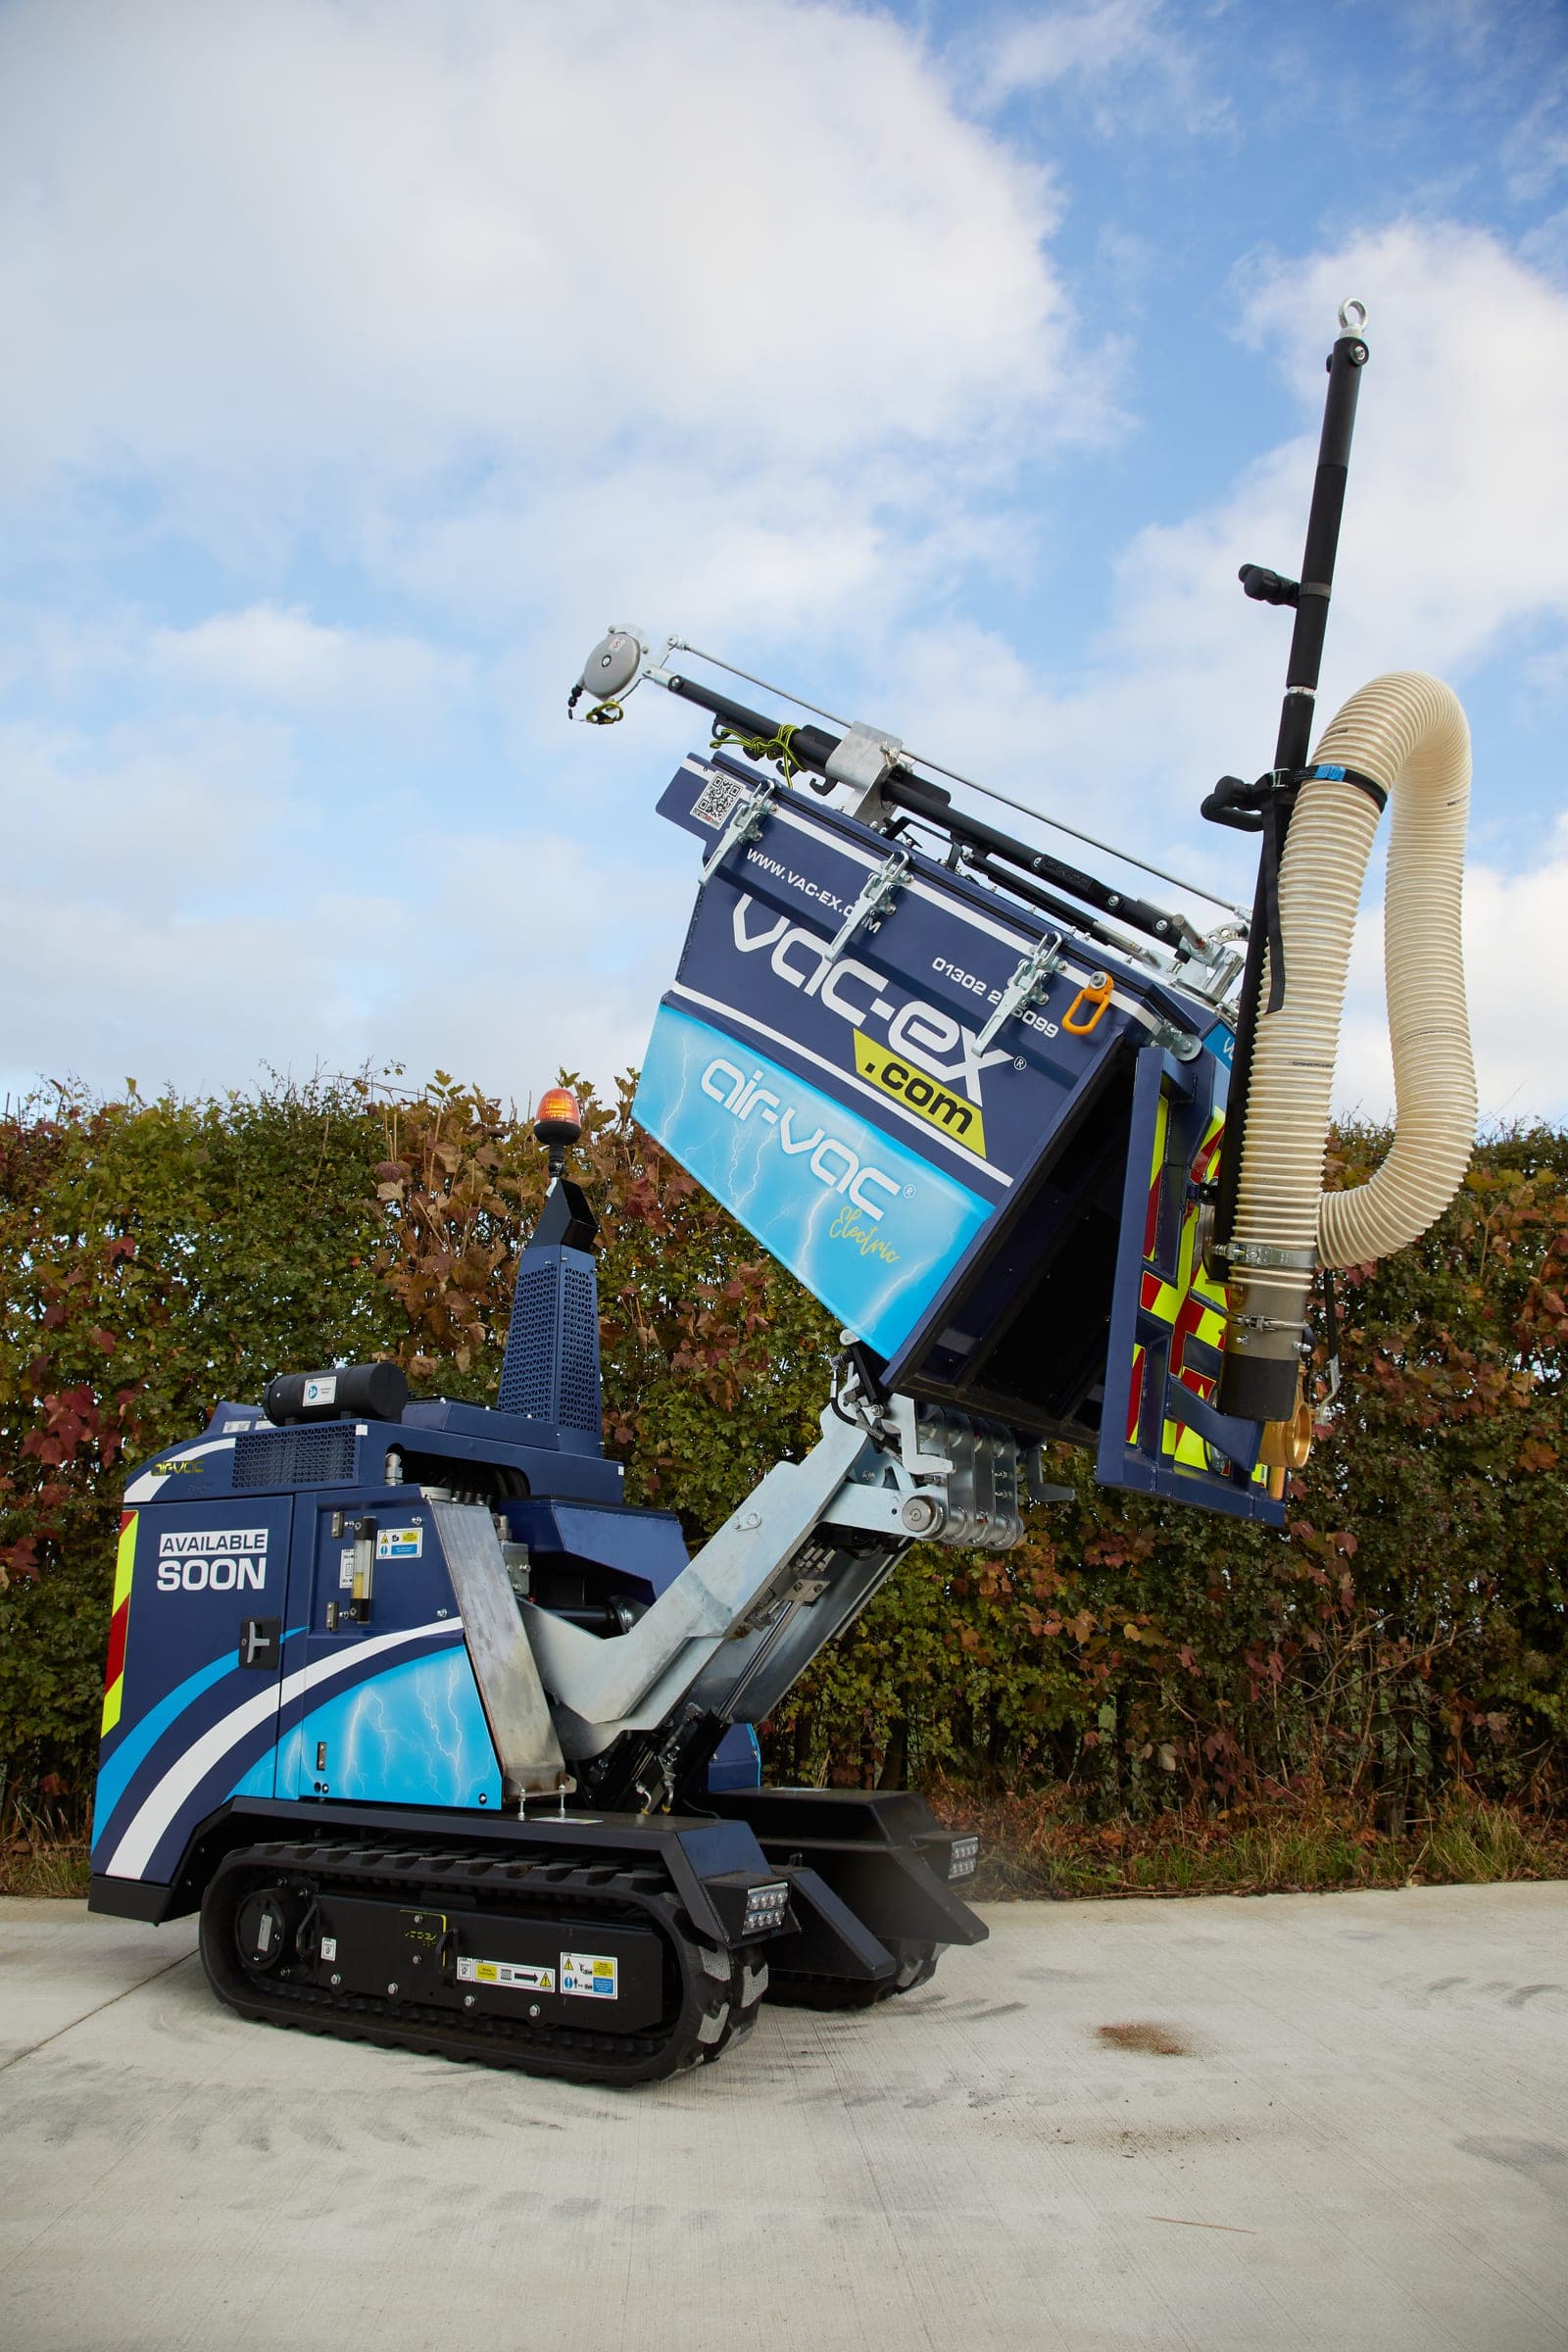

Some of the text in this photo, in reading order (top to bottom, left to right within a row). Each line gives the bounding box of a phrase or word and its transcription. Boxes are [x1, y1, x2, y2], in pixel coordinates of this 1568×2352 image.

[746, 848, 882, 934] WWW.VAC-EX.CM
[733, 893, 1014, 1107] vac-ex
[932, 956, 1059, 1039] 01302 26099
[864, 1061, 974, 1135] .com
[701, 1058, 902, 1222] air-vac
[829, 1206, 901, 1263] Electric
[157, 1557, 268, 1592] SOON
[162, 1534, 266, 1553] AVAILABLE
